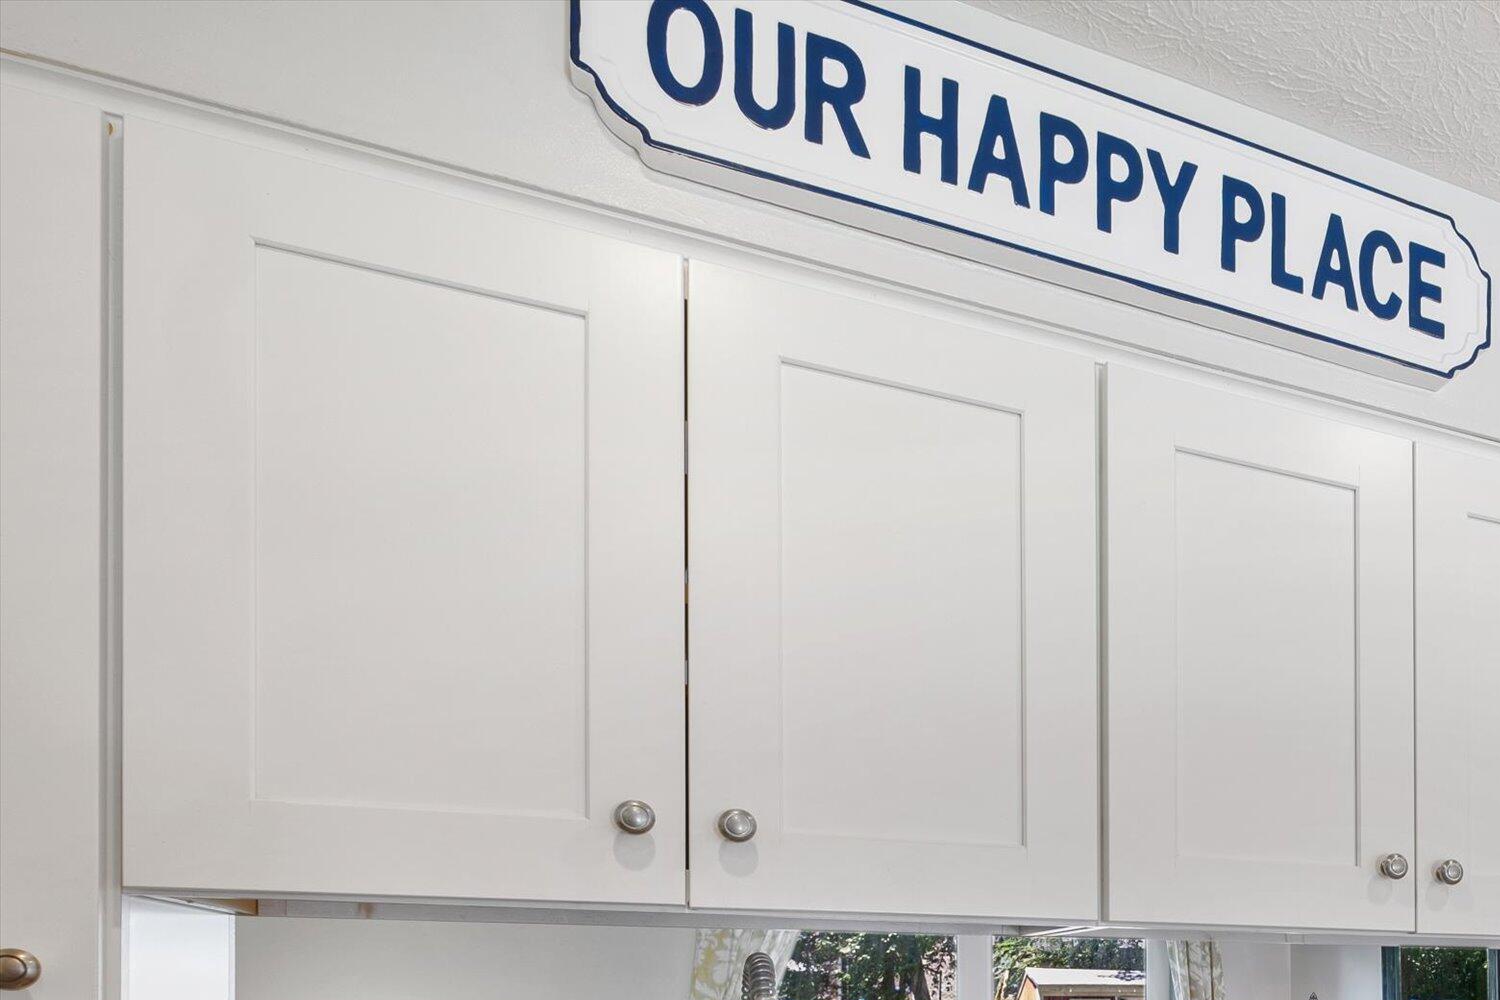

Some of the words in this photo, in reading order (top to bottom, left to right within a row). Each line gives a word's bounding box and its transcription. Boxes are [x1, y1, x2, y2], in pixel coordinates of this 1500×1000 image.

[646, 0, 871, 160] OUR
[903, 64, 1199, 256] HAPPY
[1220, 174, 1447, 341] PLACE
